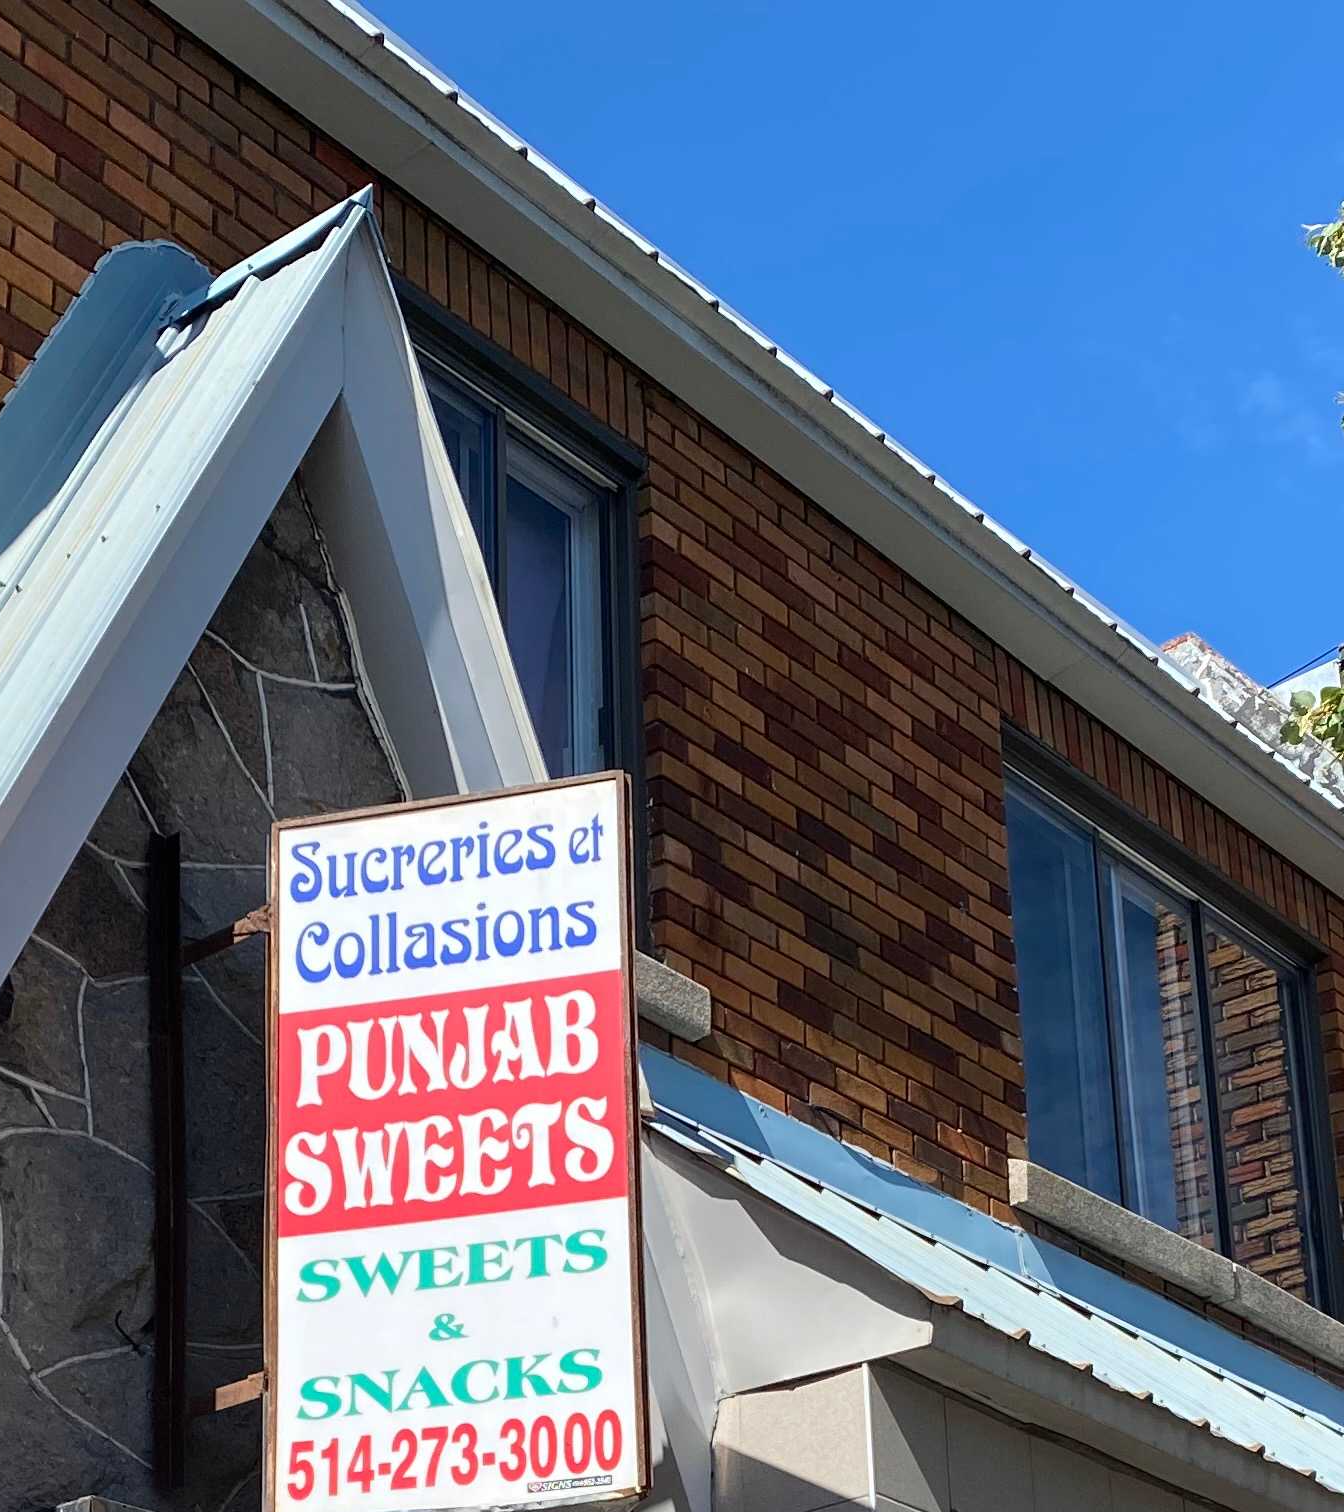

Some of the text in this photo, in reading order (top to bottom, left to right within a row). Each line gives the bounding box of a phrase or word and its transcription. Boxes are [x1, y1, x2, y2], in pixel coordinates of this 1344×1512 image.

[289, 814, 604, 903] Sucreries et
[295, 901, 598, 983] Collasions
[296, 989, 599, 1108] PUNJAB
[284, 1096, 614, 1216] SWEETS
[296, 1229, 608, 1303] SWEETS
[428, 1313, 470, 1341] &
[296, 1348, 603, 1421] SNACKS
[287, 1409, 623, 1501] 514-273-3000
